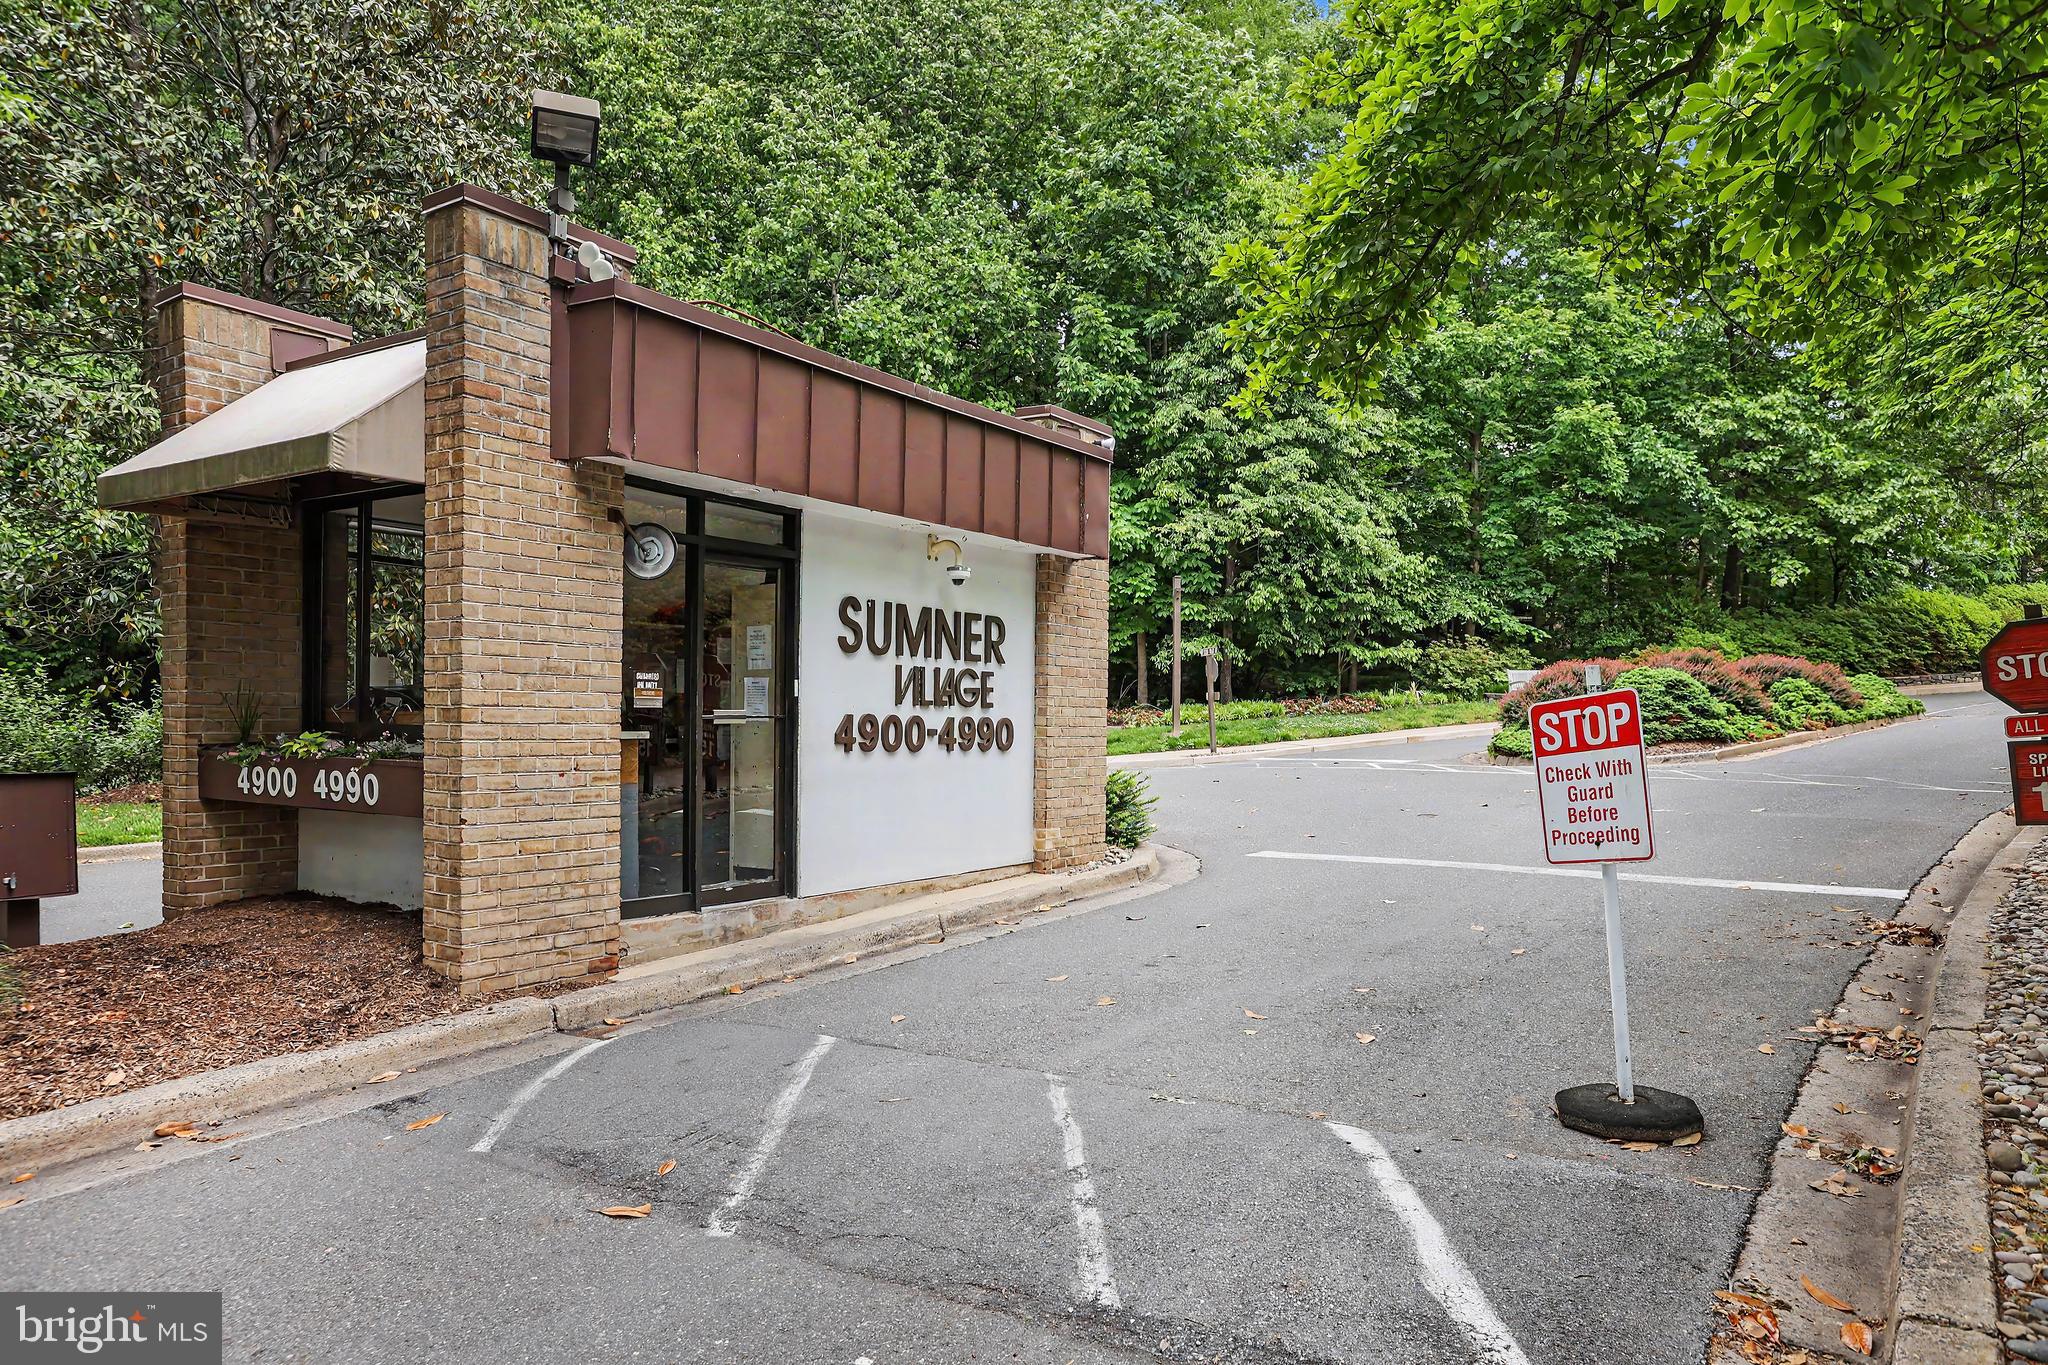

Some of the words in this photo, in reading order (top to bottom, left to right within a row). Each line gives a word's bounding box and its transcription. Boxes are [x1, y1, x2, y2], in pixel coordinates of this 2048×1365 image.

[838, 595, 1006, 665] SUMNER
[895, 665, 994, 708] VILLAGE
[834, 713, 1014, 753] 4900-4990
[1538, 702, 1631, 751] STOP
[2014, 720, 2045, 733] ALL
[2029, 753, 2048, 765] SP
[1545, 763, 1592, 784] Check
[1595, 758, 1633, 778] With
[2033, 766, 2048, 777] LI
[237, 766, 297, 798] 4900
[313, 769, 379, 806] 4990
[1567, 782, 1614, 803] Guard
[1568, 806, 1619, 824] Before
[1552, 826, 1640, 846] Proceeding
